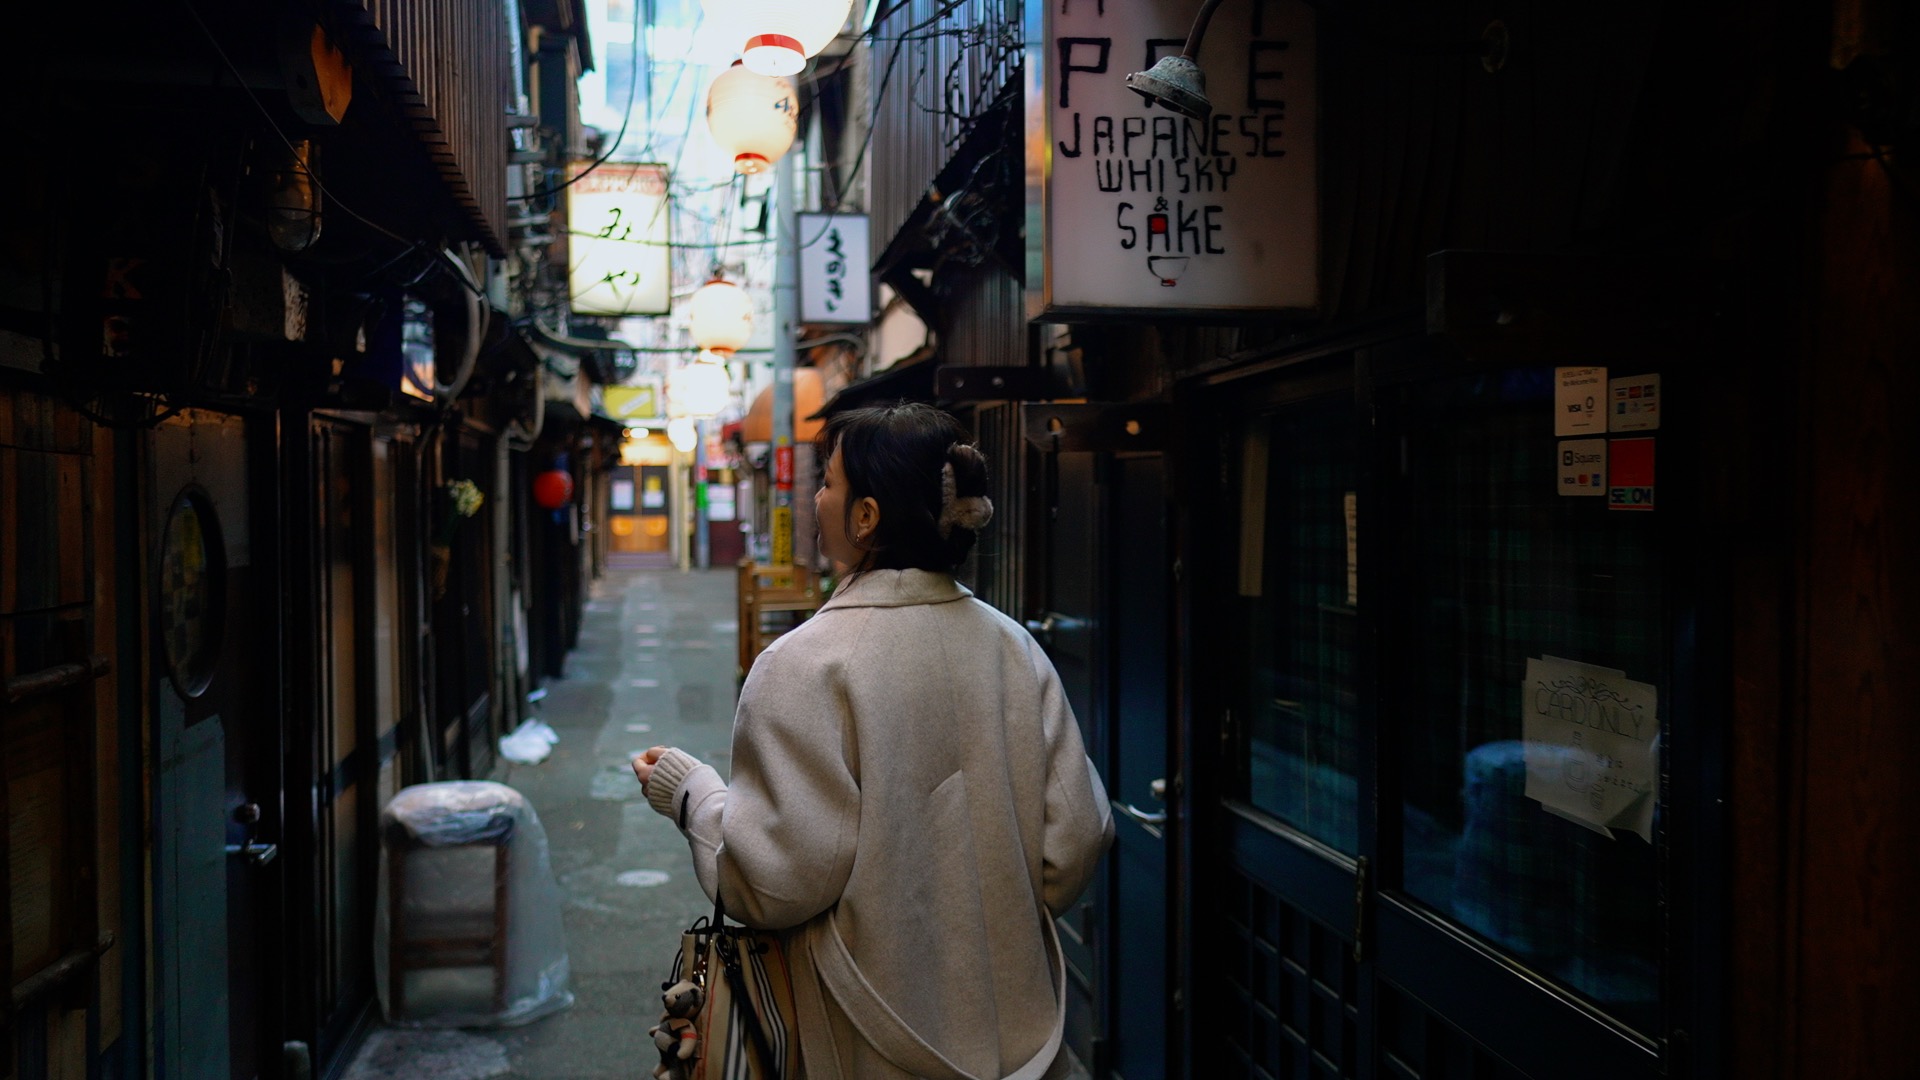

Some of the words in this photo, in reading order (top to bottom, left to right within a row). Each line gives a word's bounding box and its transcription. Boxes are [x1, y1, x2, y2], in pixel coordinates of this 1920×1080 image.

[1058, 113, 1286, 159] JAPANESE
[1096, 157, 1236, 194] WHISKY
[1153, 195, 1169, 212] &
[1117, 200, 1226, 255] SAKE
[1567, 403, 1582, 413] VISA
[1574, 452, 1601, 466] Square
